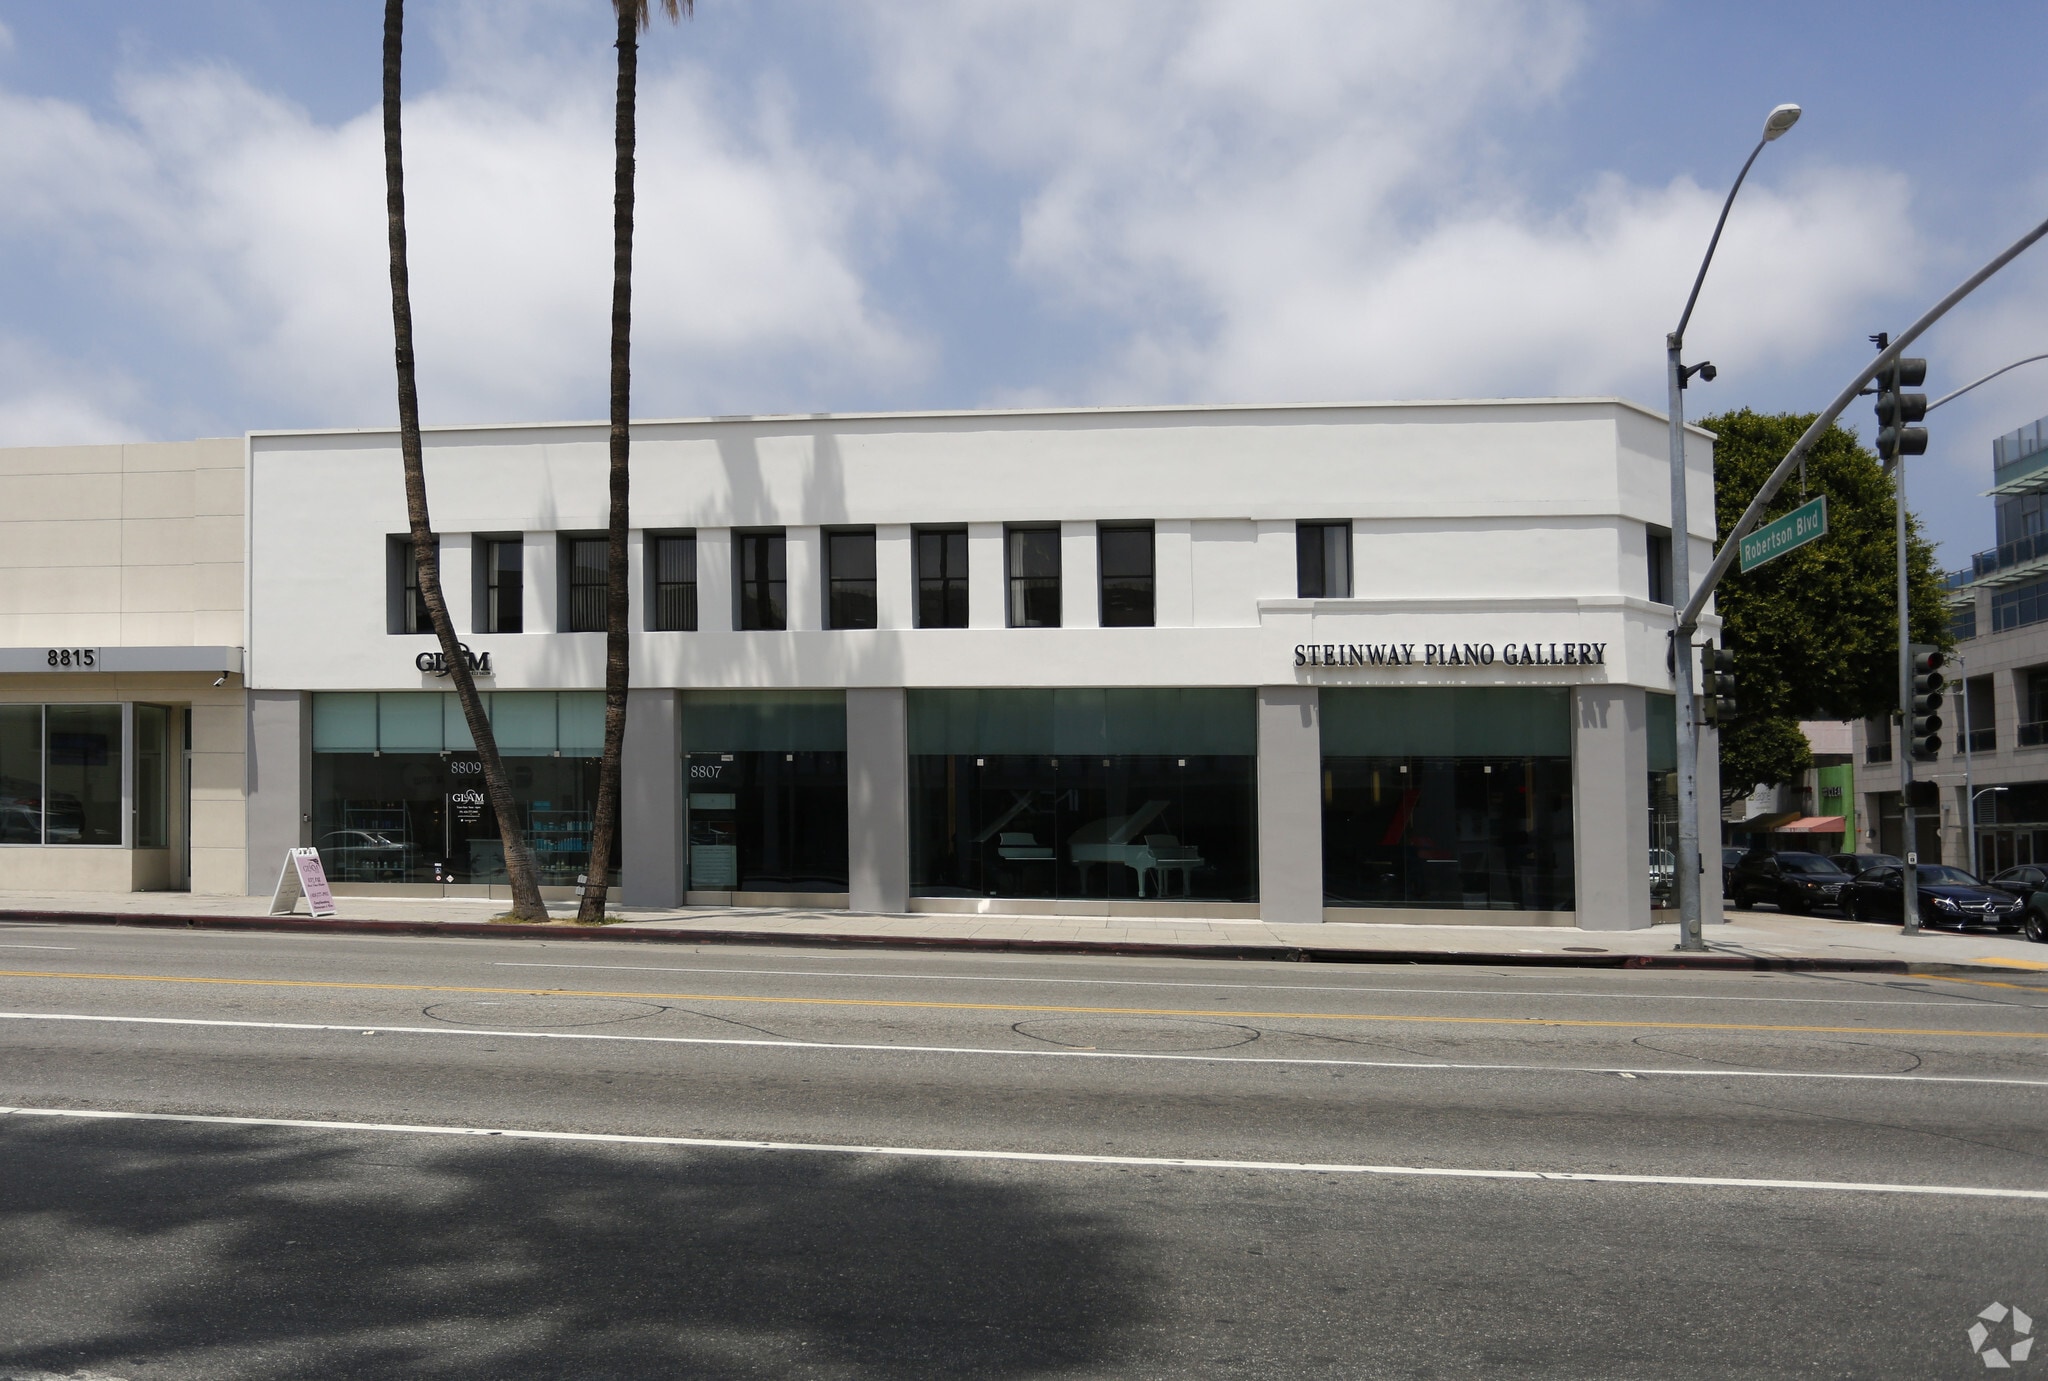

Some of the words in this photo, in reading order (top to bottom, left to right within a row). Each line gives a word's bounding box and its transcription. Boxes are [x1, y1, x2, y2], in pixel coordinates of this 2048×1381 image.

[1745, 527, 1793, 562] Robertson
[1796, 510, 1818, 536] Blvd
[48, 649, 95, 666] 8815
[415, 648, 490, 673] GLM
[1294, 643, 1416, 666] STEINWAY
[1424, 643, 1495, 665] PIANO
[1503, 643, 1607, 665] GALLERY
[451, 761, 482, 774] 8809
[690, 765, 722, 778] 8807
[452, 791, 484, 803] GLAM
